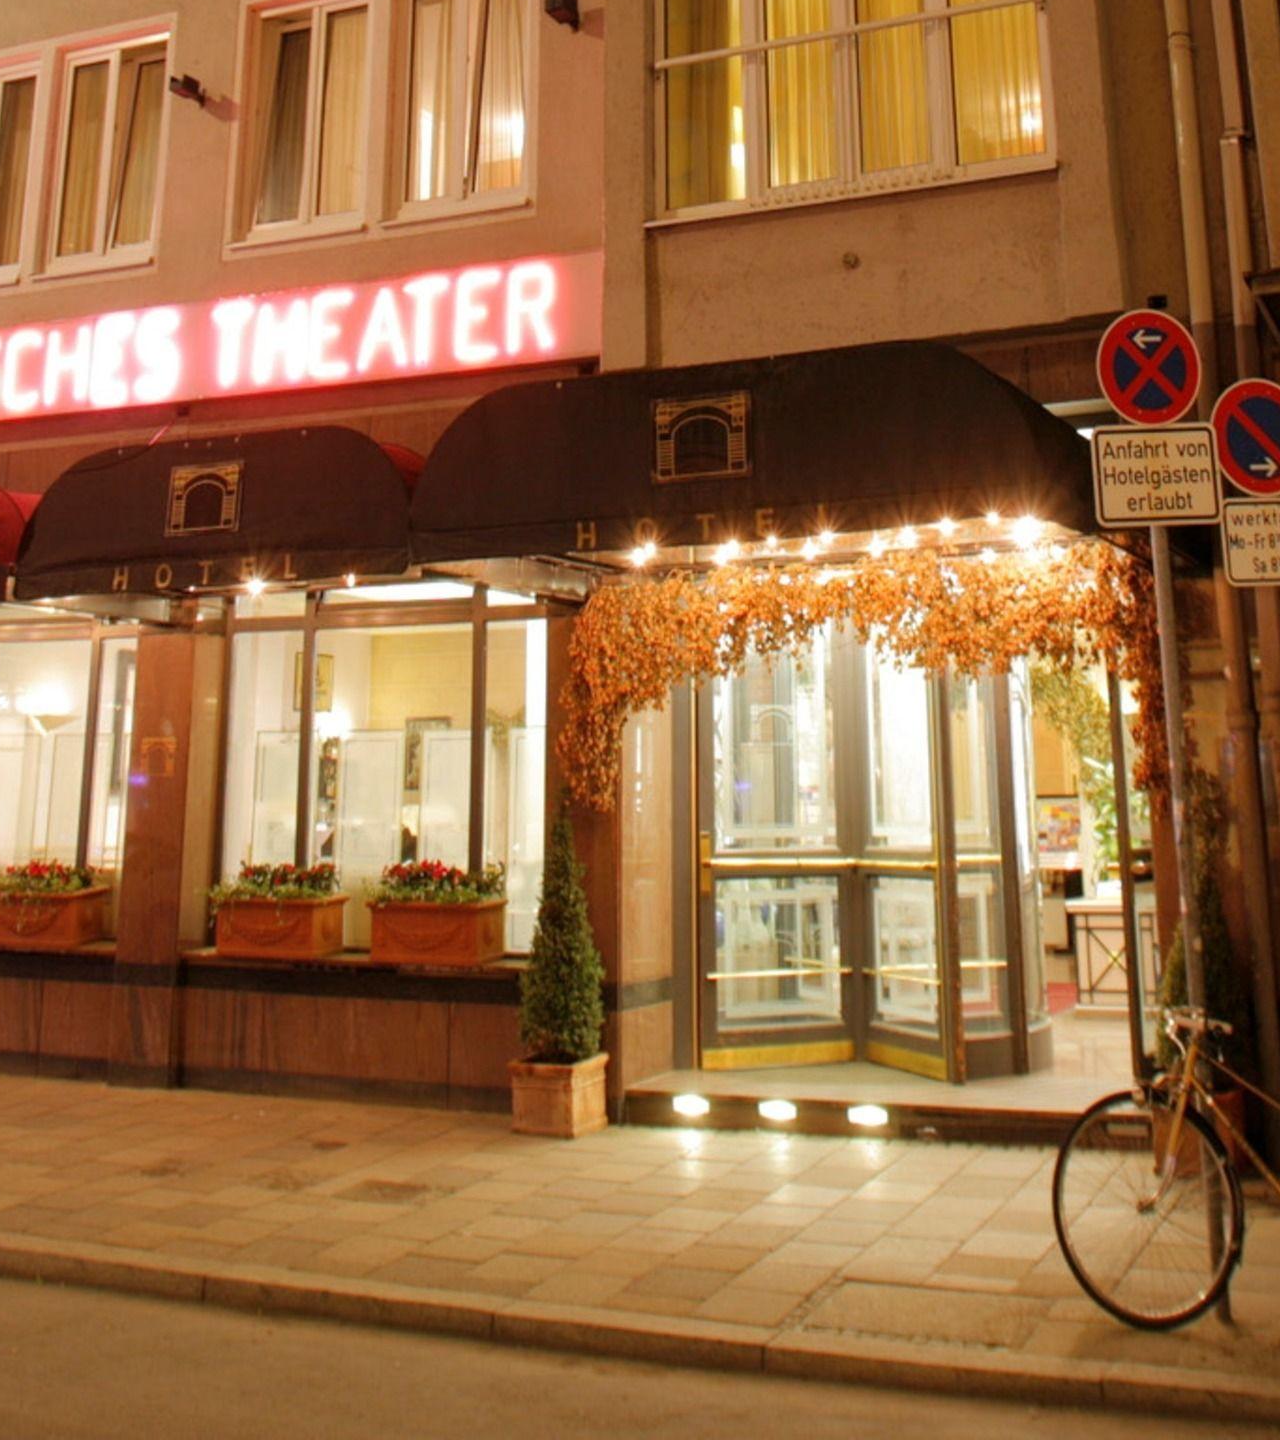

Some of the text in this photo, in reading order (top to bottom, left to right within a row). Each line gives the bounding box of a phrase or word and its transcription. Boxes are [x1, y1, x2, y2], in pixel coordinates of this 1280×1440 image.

[210, 255, 560, 393] THEATER
[1103, 440, 1208, 460] Anfahrt von
[1103, 465, 1210, 489] Hotelgästen
[1126, 491, 1193, 511] erlaubt
